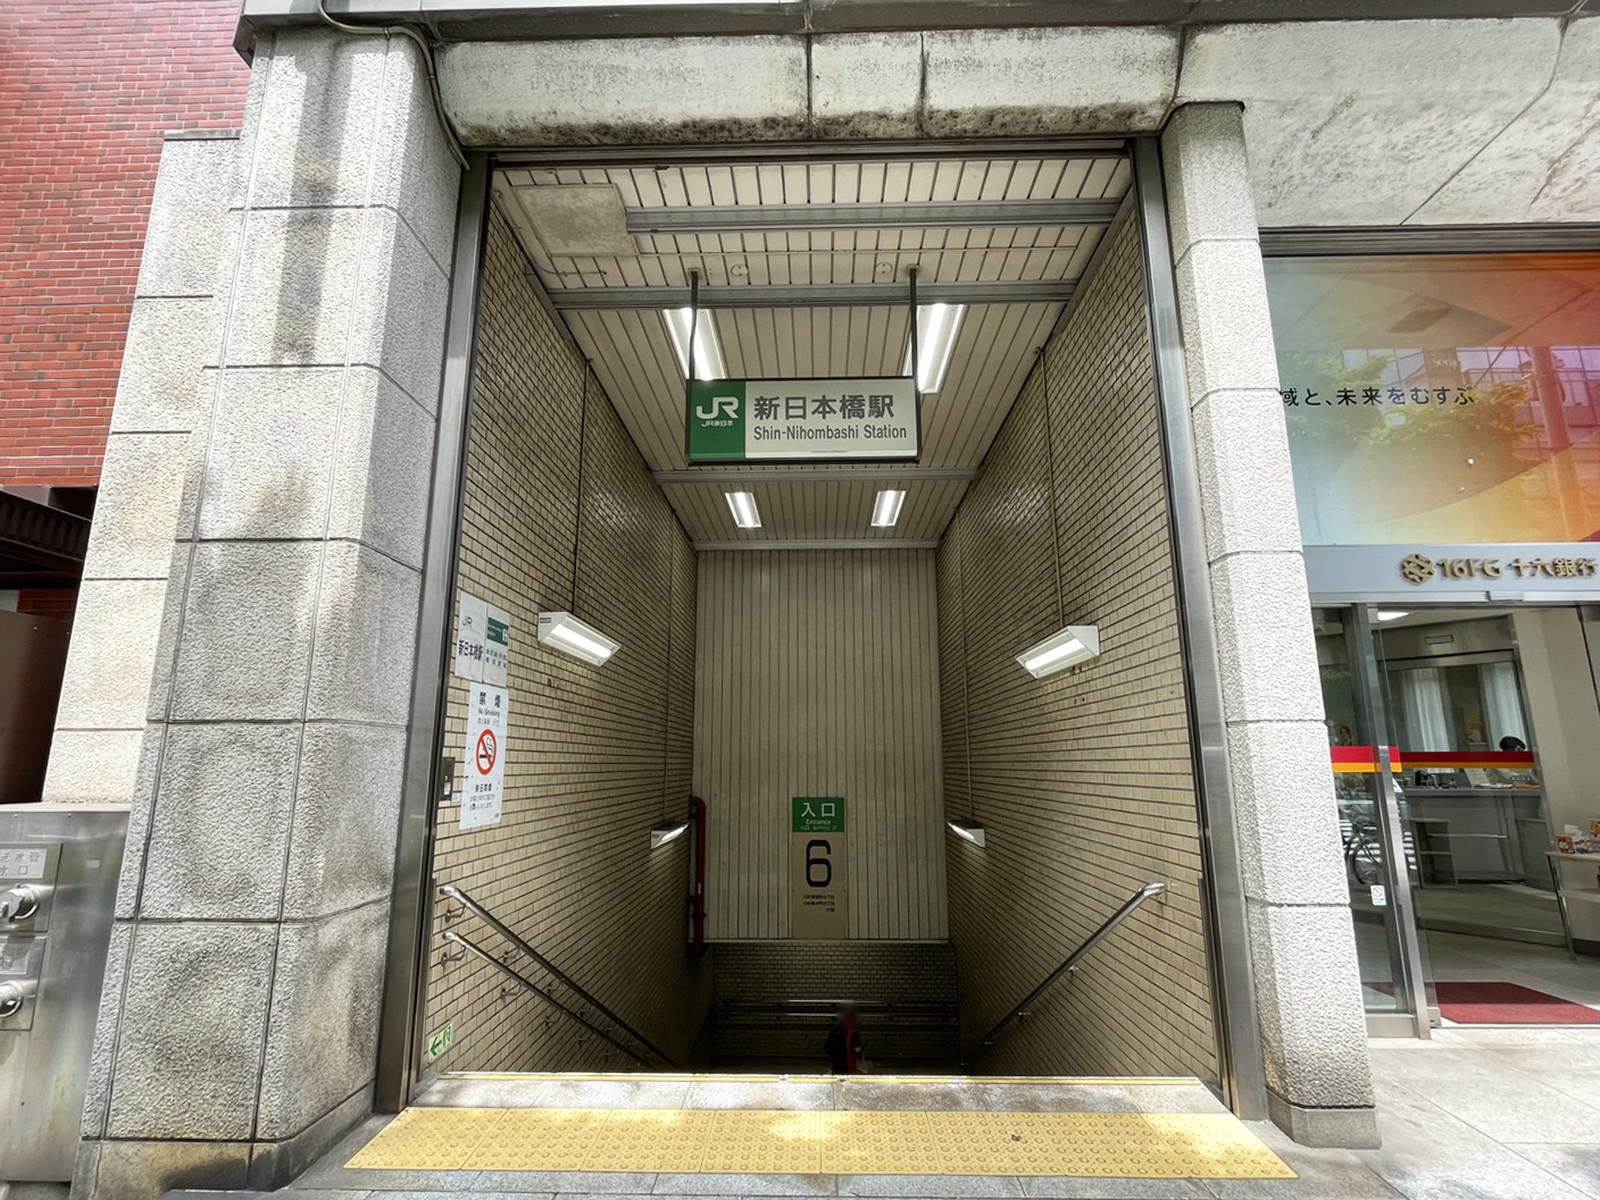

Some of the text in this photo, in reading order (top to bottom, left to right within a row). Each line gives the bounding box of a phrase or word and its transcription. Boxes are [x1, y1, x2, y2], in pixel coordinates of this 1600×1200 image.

[696, 396, 739, 420] JR
[754, 394, 894, 420] 新日本橋駅
[753, 424, 907, 441] Shin-Nihombashi Station
[1510, 557, 1599, 578] 十六銀行
[801, 802, 835, 818] 入口
[805, 839, 832, 888] 6
